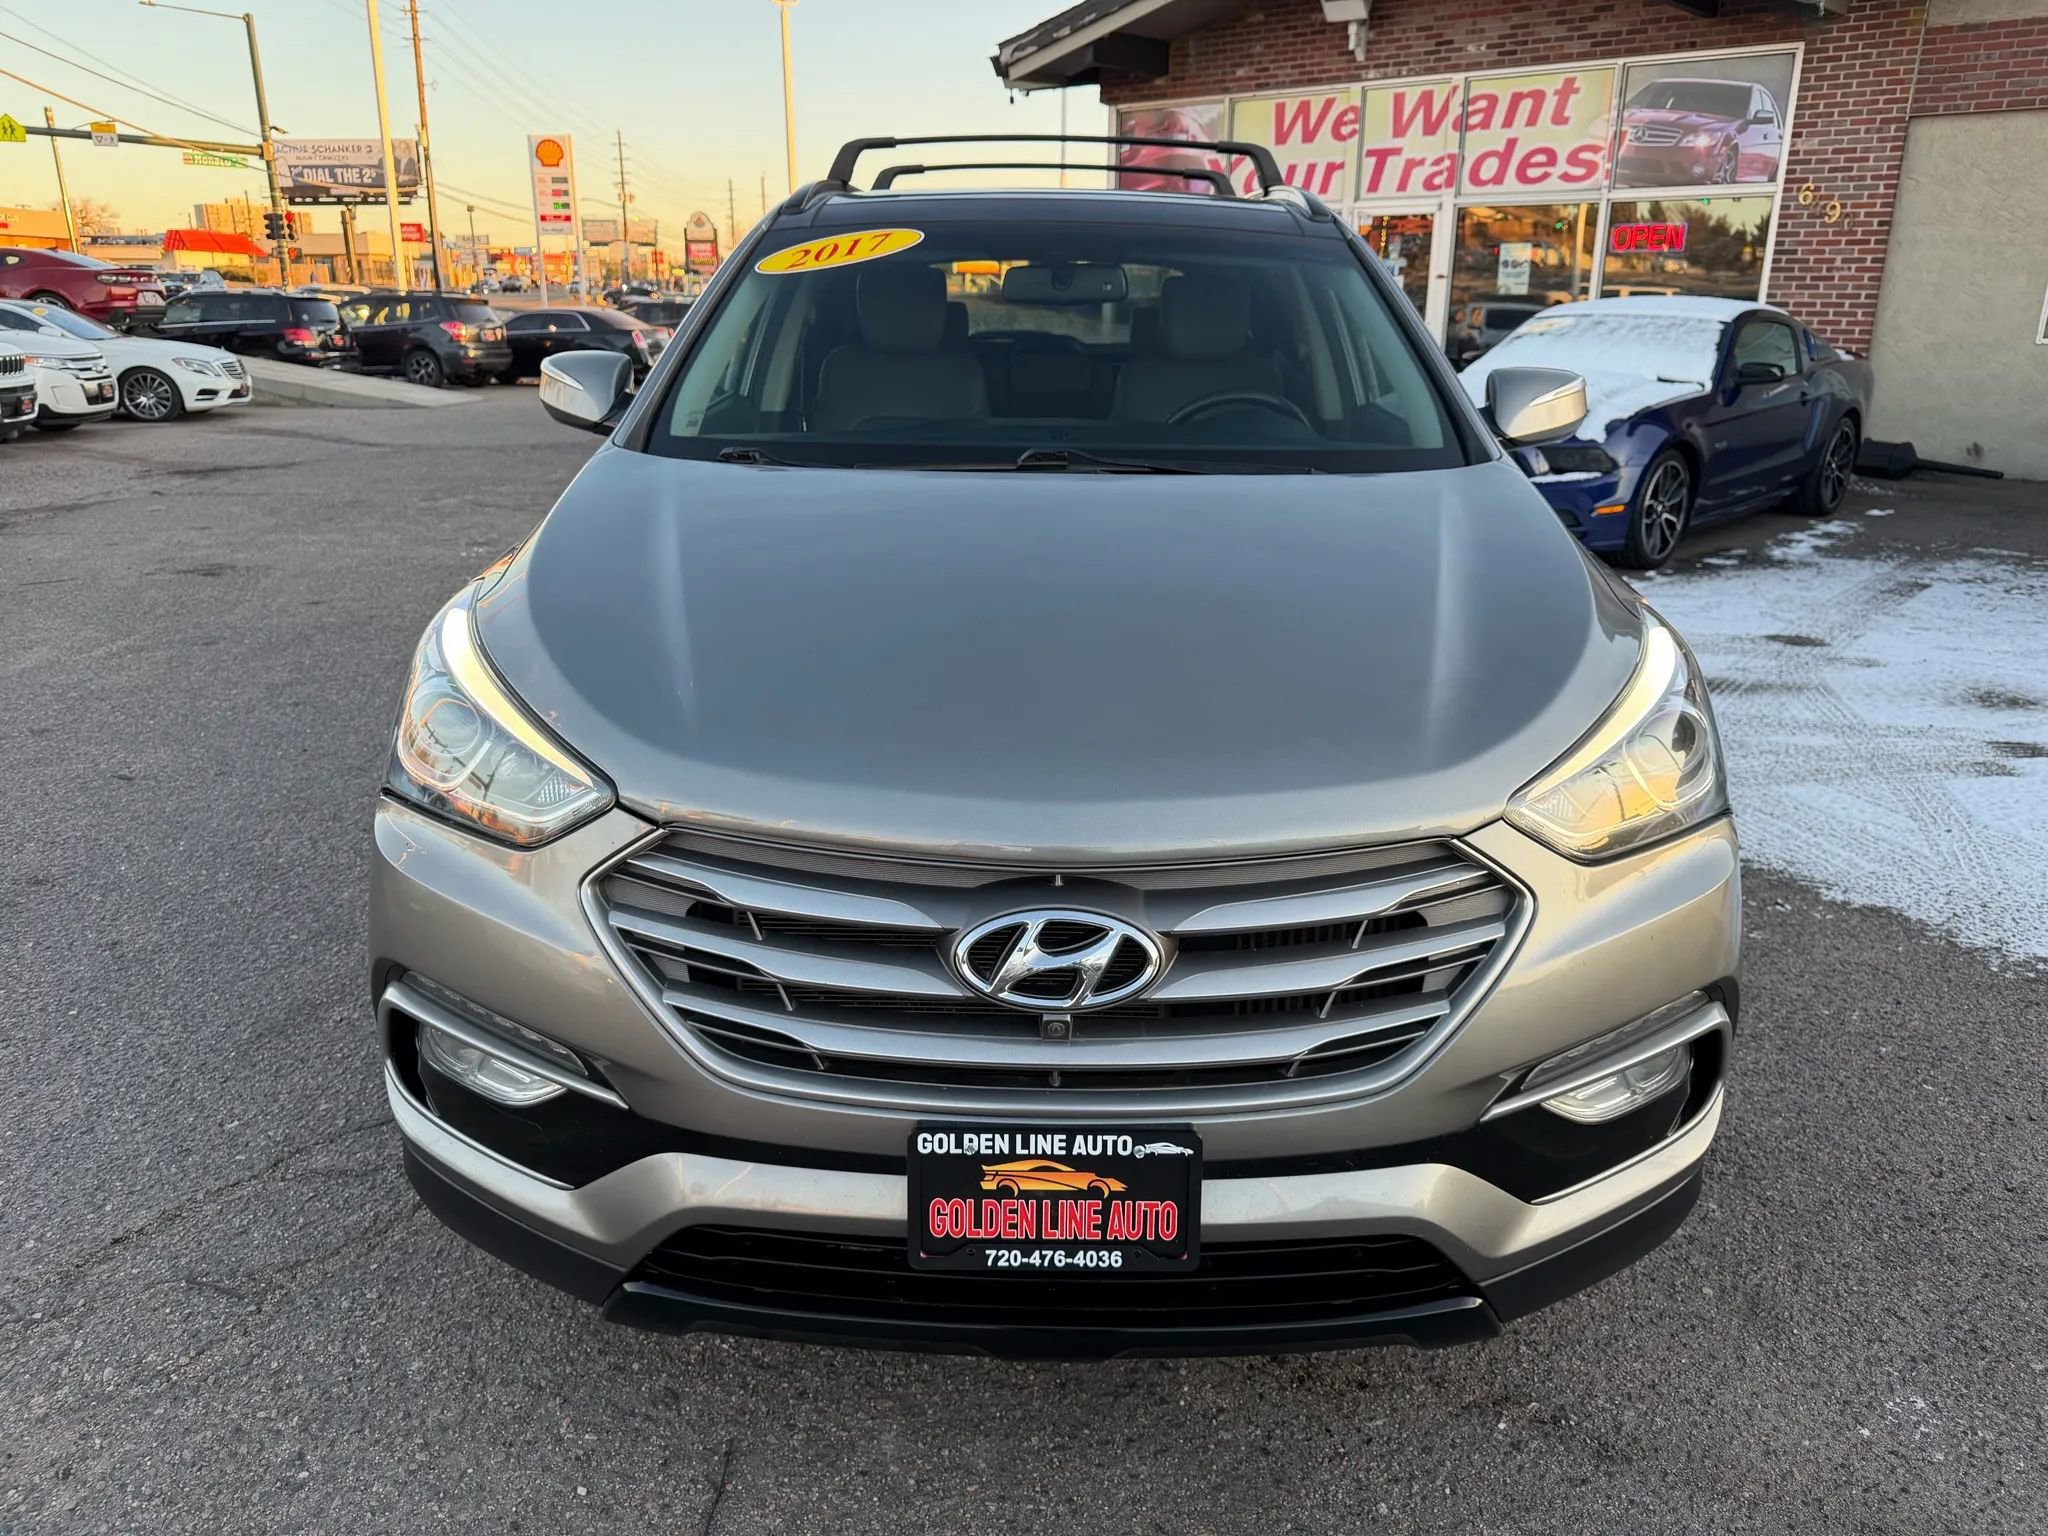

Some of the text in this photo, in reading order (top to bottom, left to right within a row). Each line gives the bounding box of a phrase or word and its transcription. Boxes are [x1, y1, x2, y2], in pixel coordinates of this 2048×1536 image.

[1274, 76, 1581, 146] We Want
[302, 167, 334, 183] DIAL
[335, 167, 362, 184] THE
[1364, 130, 1628, 193] Trades!
[784, 232, 893, 270] 2017
[1612, 224, 1685, 252] OPEN
[917, 1133, 1133, 1157] GOLDEN LINE AUTO
[929, 1197, 1178, 1241] GOLDEN LINE AUTO
[985, 1250, 1123, 1268] 720-476-4036
